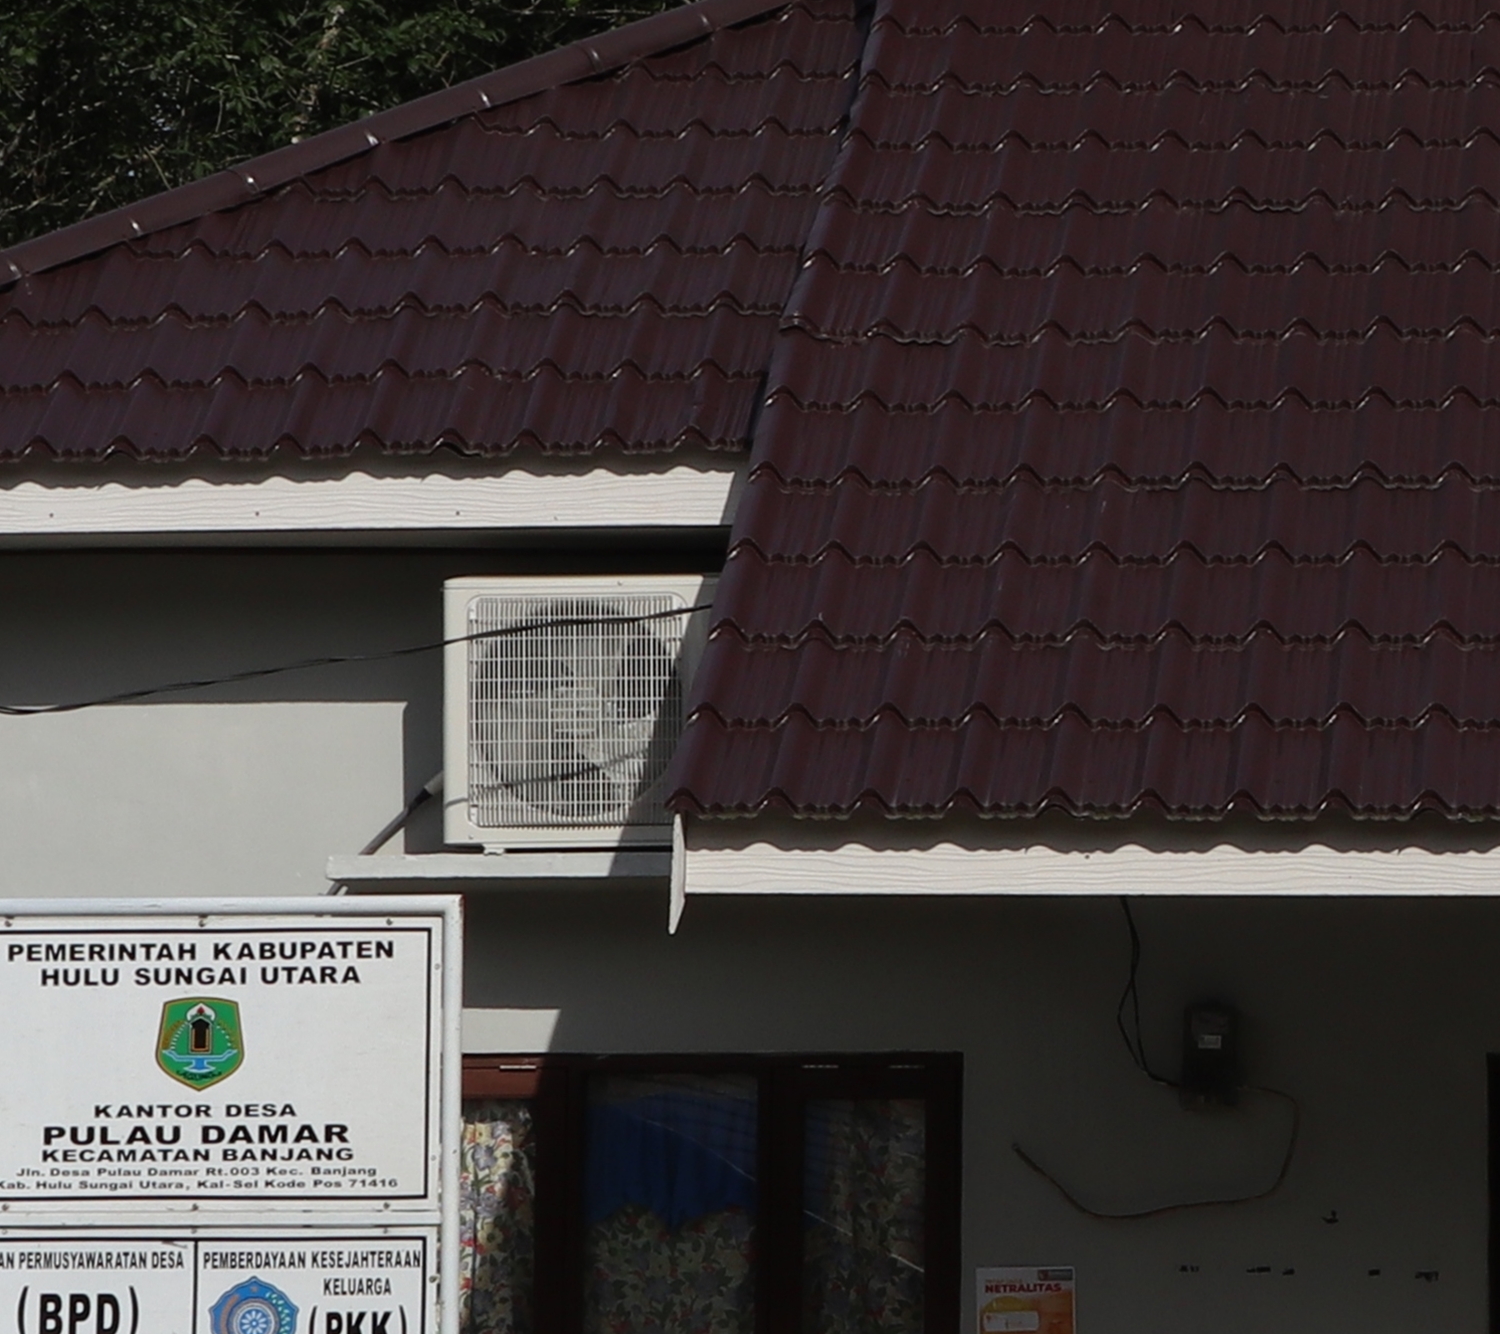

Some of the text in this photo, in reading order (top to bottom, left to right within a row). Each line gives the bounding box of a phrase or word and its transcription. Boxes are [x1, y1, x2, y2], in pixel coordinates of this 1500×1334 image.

[7, 940, 394, 962] PEMERINTAH KABUPATEN
[41, 965, 361, 987] HULU SUNGAI UTARA
[94, 1103, 297, 1119] KANTOR DESA
[43, 1123, 349, 1146] PULAU DAMAR
[42, 1147, 354, 1163] KECAMATAN BANJANG
[16, 1166, 377, 1178] Jln. Desa Pulau Damar Rt.003 Kec. Banjang
[35, 1180, 73, 1190] Hulu
[78, 1180, 133, 1192] Sungai
[138, 1180, 190, 1191] Utara,
[196, 1179, 259, 1189] Kal-Sel
[264, 1179, 306, 1189] Kode
[312, 1178, 343, 1189] Pos
[348, 1178, 398, 1188] 71416
[18, 1251, 148, 1270] PERMUSYAWARATAN
[151, 1250, 185, 1269] DESA
[202, 1250, 422, 1270] PEMBERDAYAAN KESEJAHTERAAN
[323, 1277, 392, 1296] KELUARGA
[985, 1283, 1063, 1294] NETRALITAS
